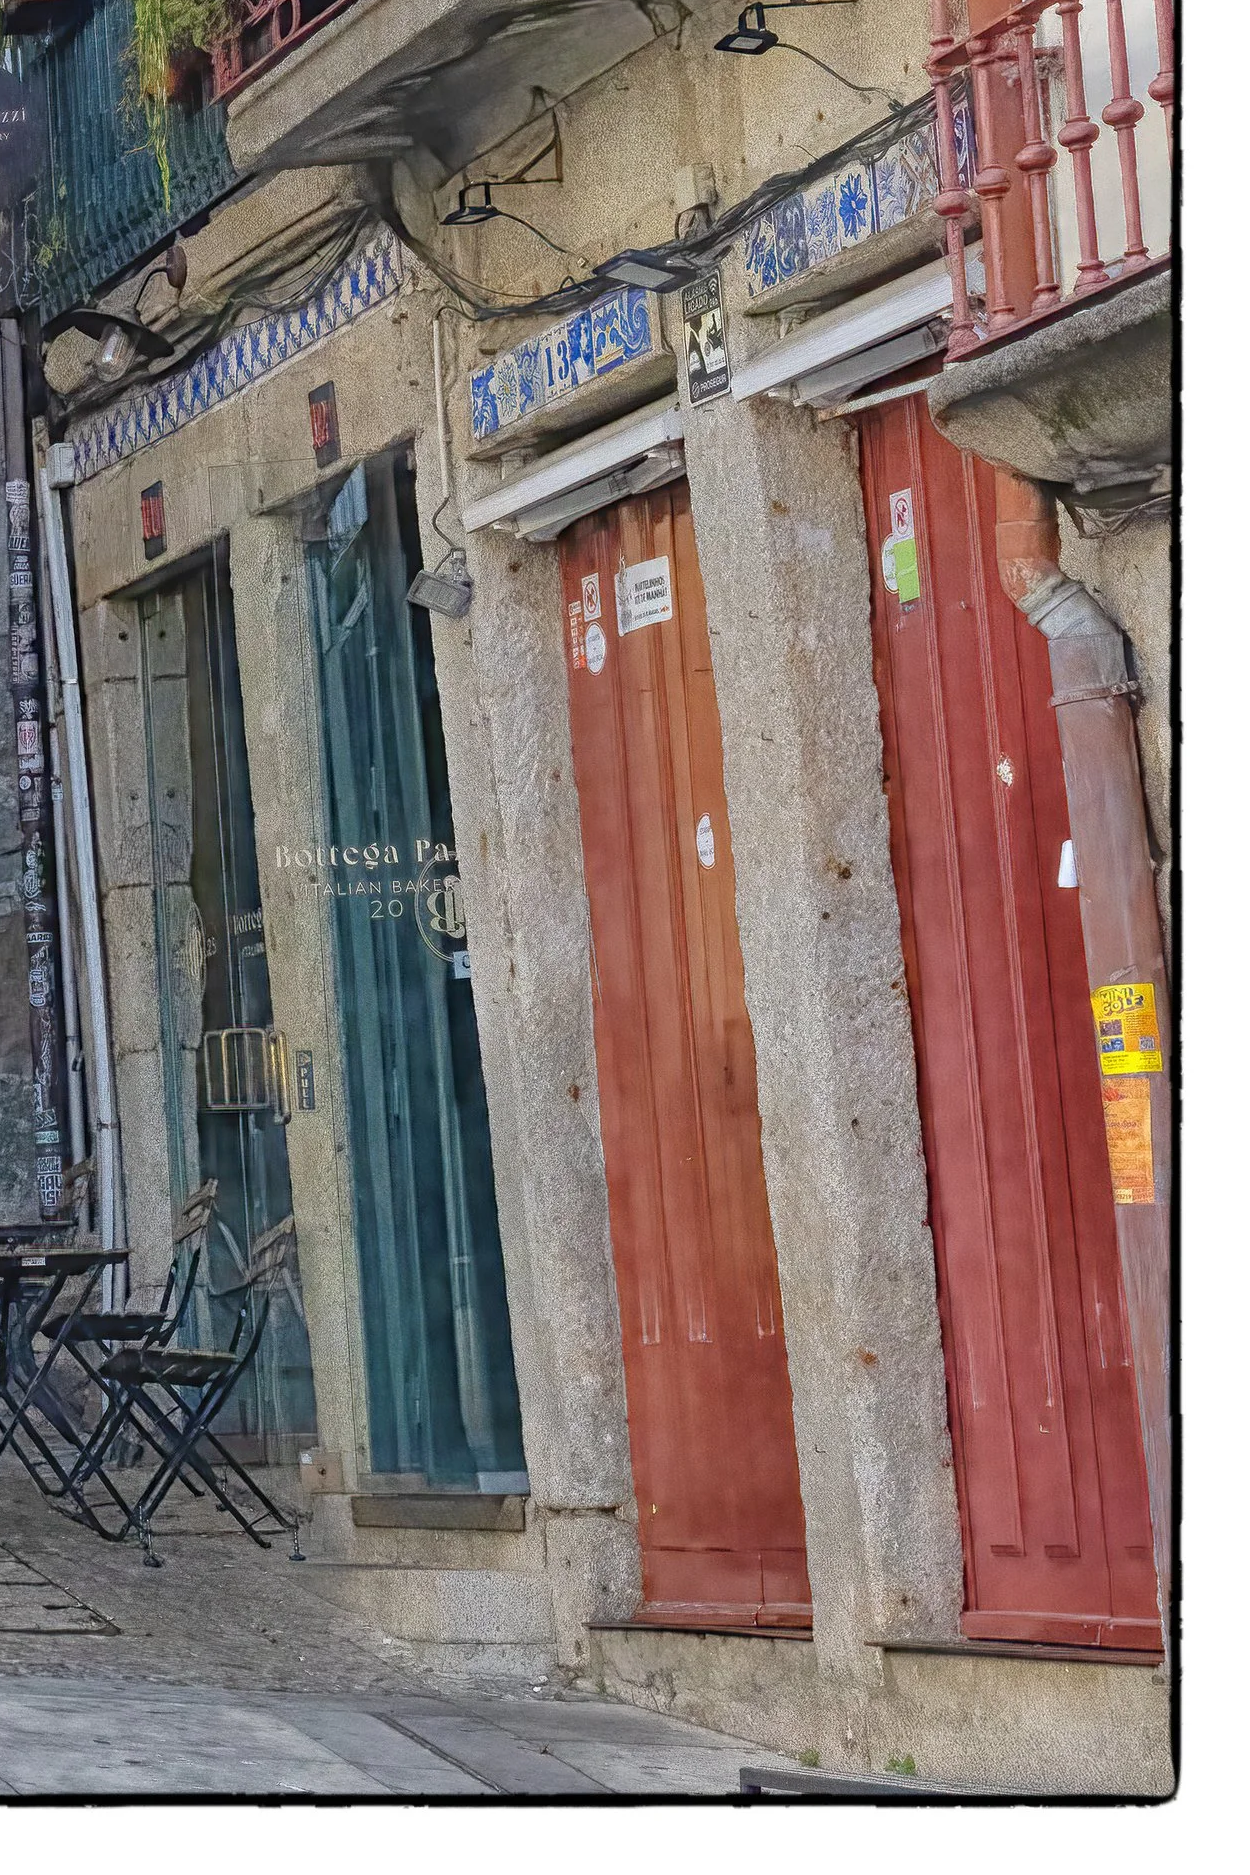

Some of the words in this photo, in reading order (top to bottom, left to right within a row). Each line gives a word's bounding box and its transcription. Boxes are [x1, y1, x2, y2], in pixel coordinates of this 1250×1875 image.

[545, 340, 569, 387] 13
[700, 373, 728, 393] PROSEGUR
[276, 842, 399, 870] Bottega
[300, 881, 381, 898] ITALIAN
[370, 899, 403, 918] 20
[1100, 987, 1134, 1002] MINI
[1102, 995, 1144, 1015] GOLF
